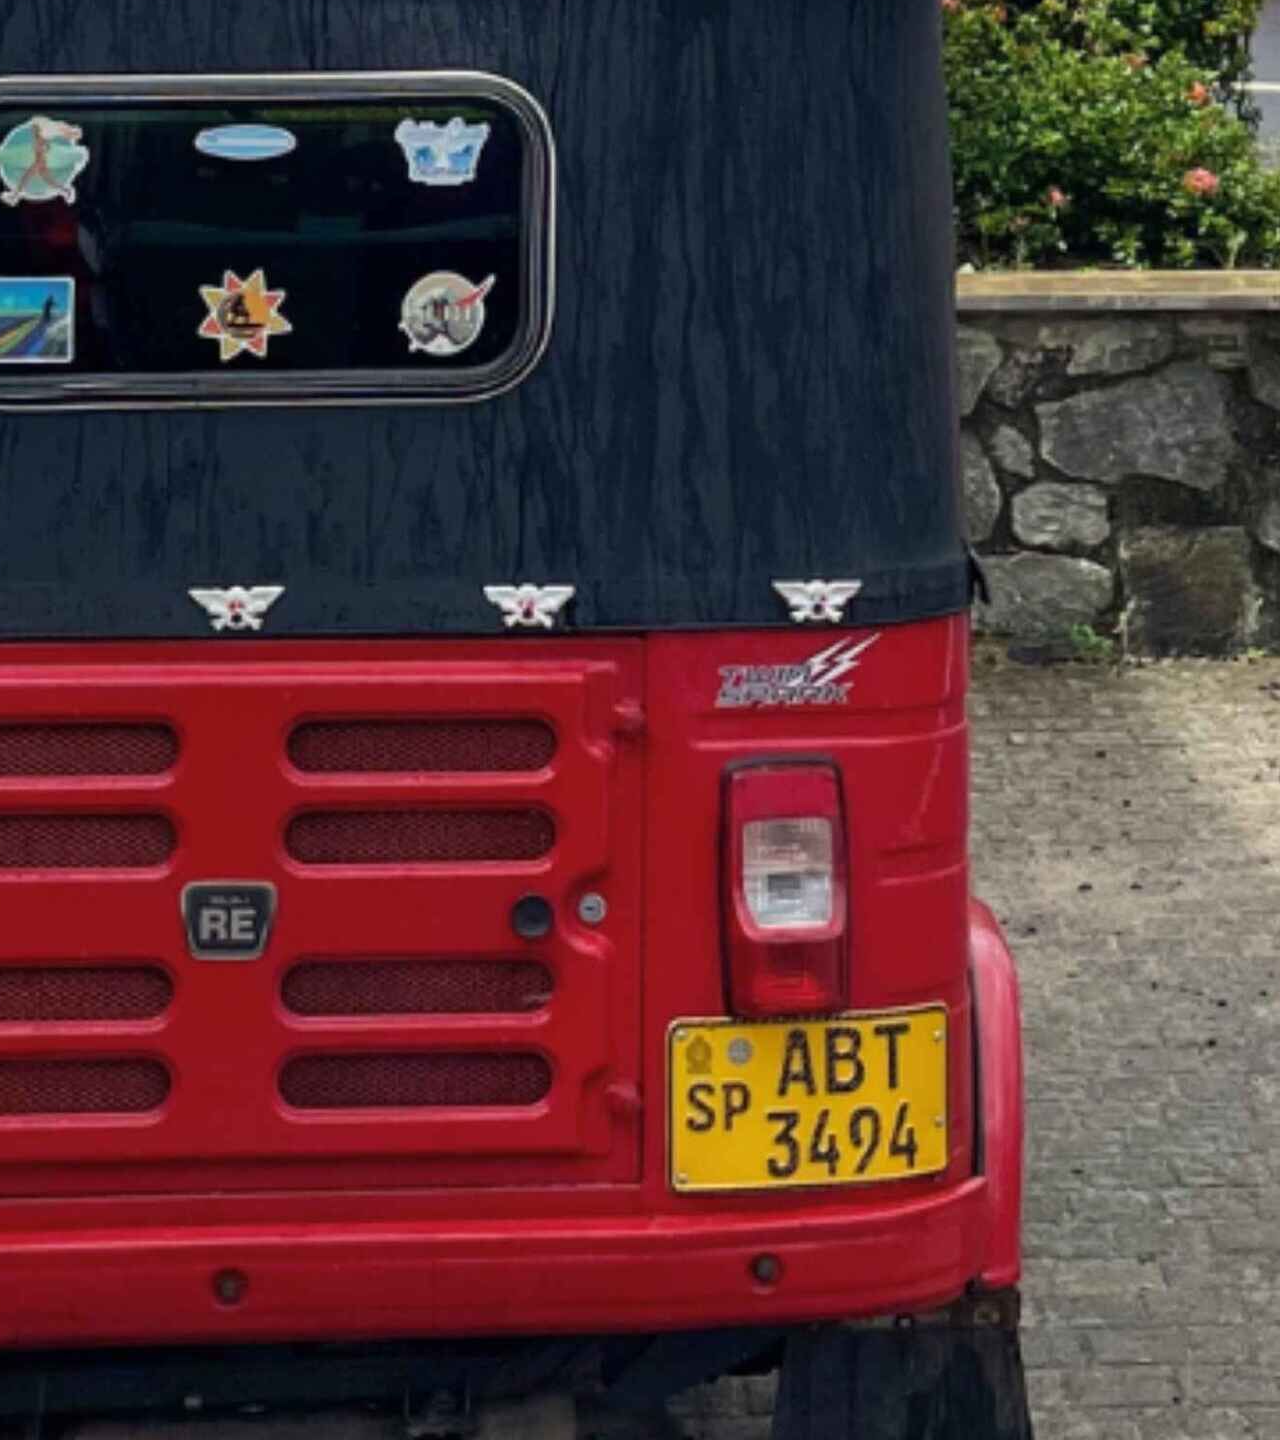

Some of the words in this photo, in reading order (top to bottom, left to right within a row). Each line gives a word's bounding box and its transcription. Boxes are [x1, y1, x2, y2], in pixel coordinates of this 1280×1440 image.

[200, 908, 257, 940] RE
[776, 1023, 911, 1097] ABT
[686, 1082, 752, 1132] SP
[767, 1101, 918, 1179] 3494
